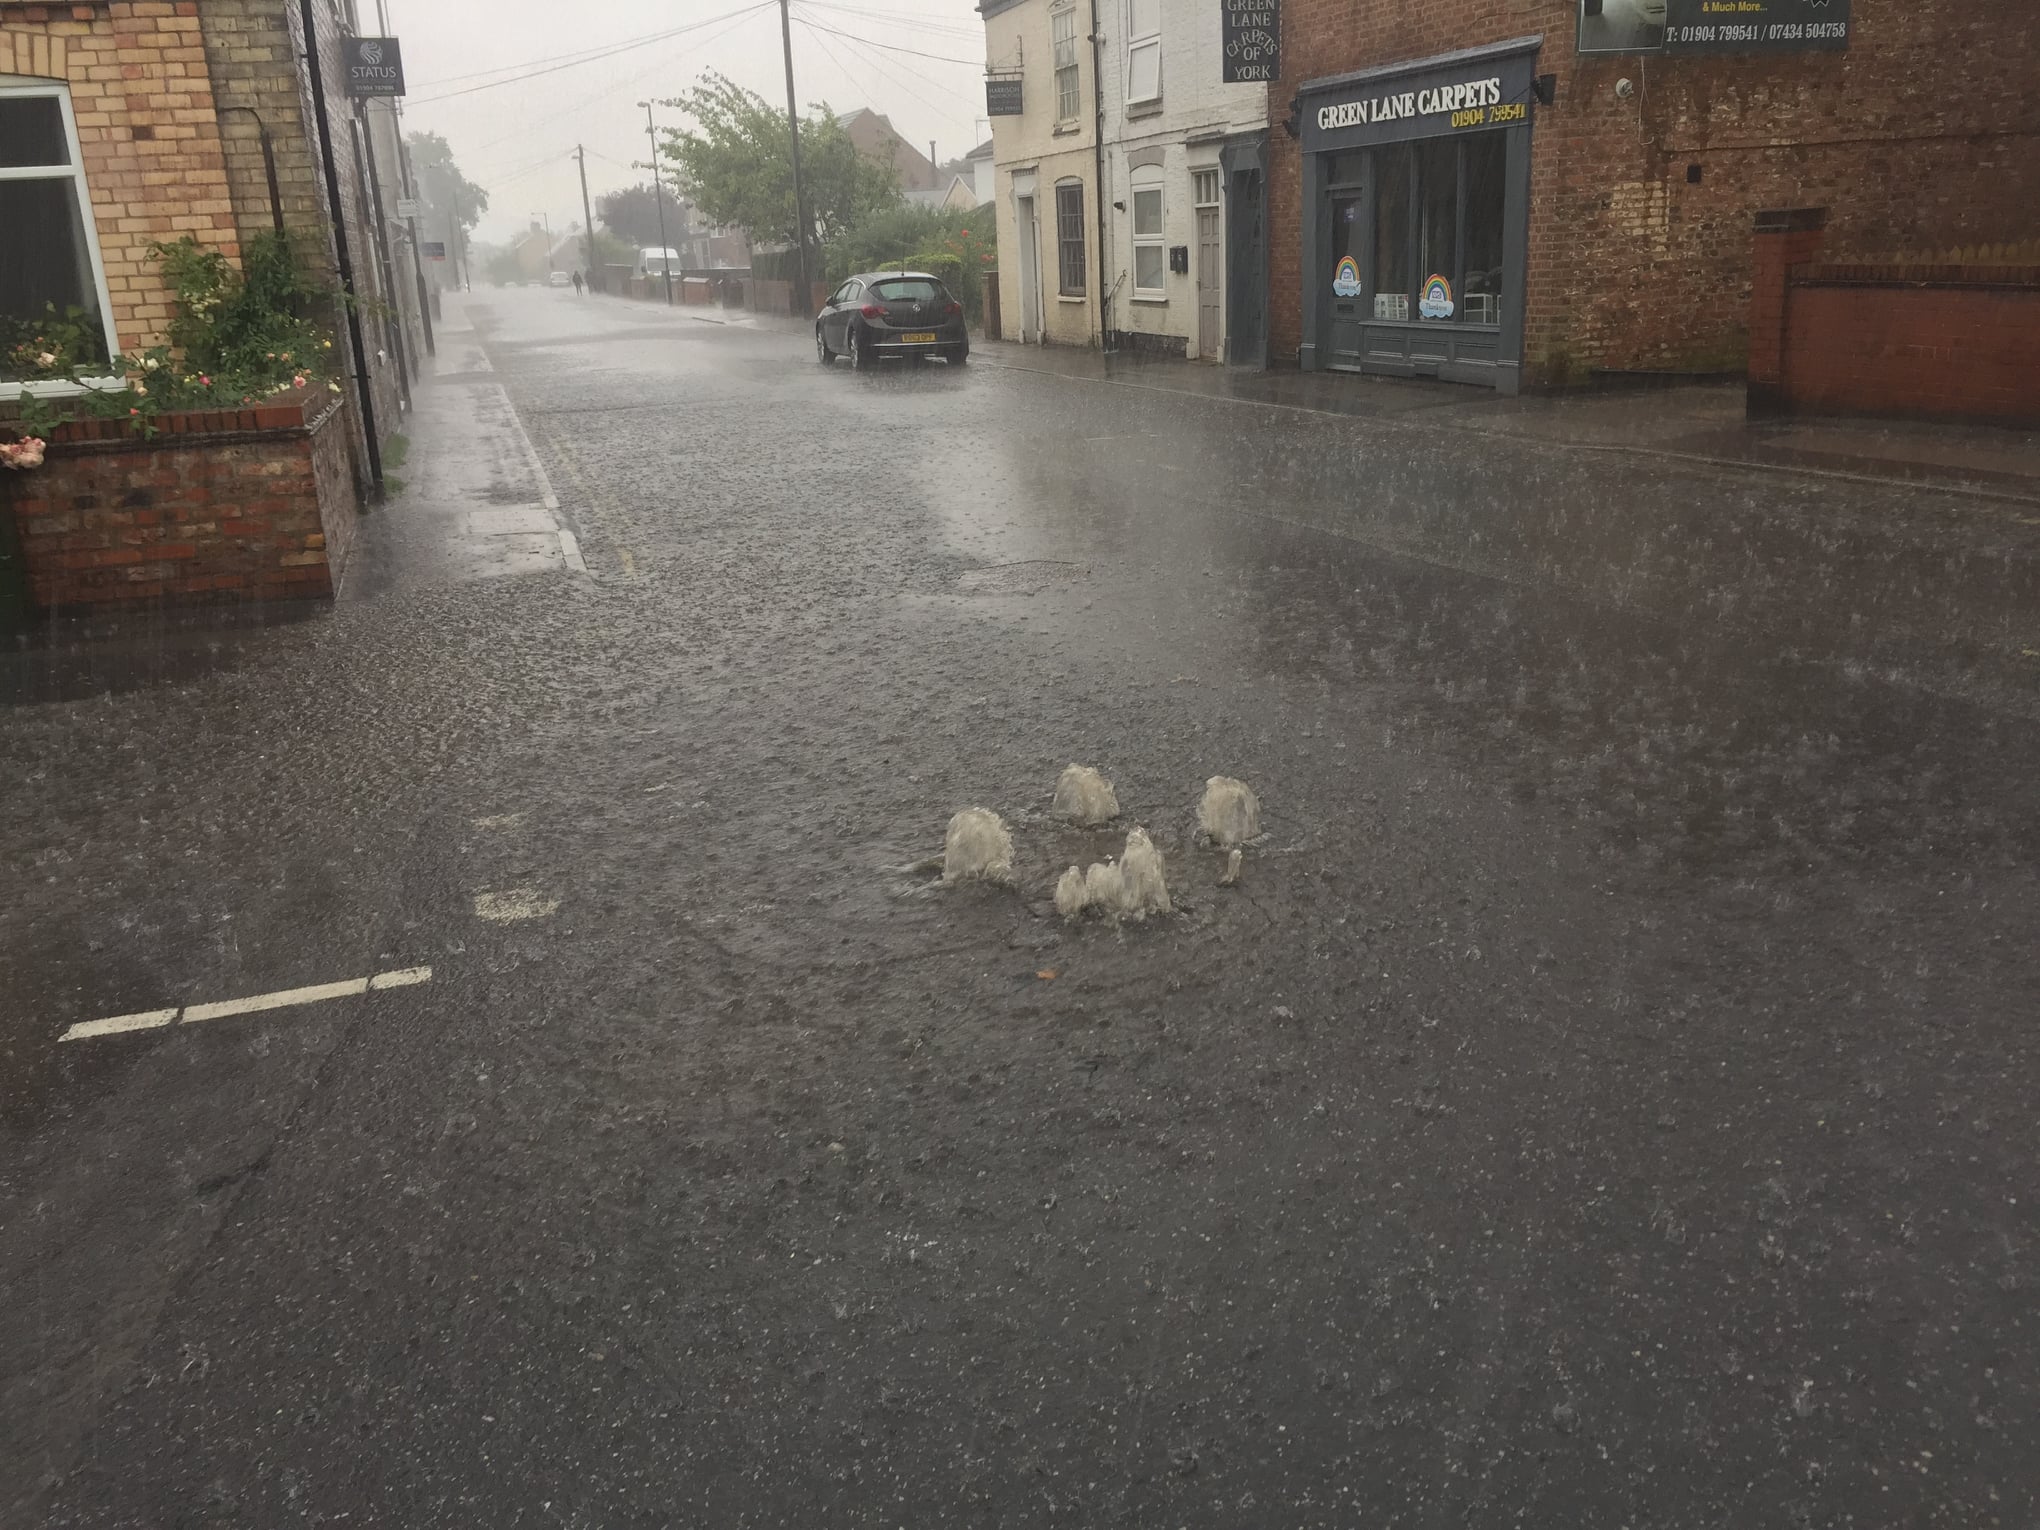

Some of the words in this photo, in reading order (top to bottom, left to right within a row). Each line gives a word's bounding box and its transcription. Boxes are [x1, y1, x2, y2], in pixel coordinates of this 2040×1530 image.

[1227, 0, 1275, 11] GREEN
[1702, 1, 1710, 12] &
[1711, 1, 1736, 12] Much
[1738, 1, 1768, 12] More...
[1231, 12, 1271, 28] LANE
[1666, 26, 1678, 42] T:
[1681, 25, 1717, 42] 01904
[1719, 24, 1759, 41] 799541
[1769, 23, 1803, 40] 07434
[1805, 22, 1846, 39] 504758
[1226, 28, 1278, 57] CARPETS
[1243, 46, 1262, 61] OF
[351, 66, 397, 78] STATUS
[1234, 64, 1271, 80] YORK
[1317, 100, 1368, 130] GREEN
[1371, 92, 1415, 122] LANE
[1417, 77, 1501, 115] CARPETS
[1451, 108, 1485, 128] 01904
[1488, 102, 1526, 123] 799541
